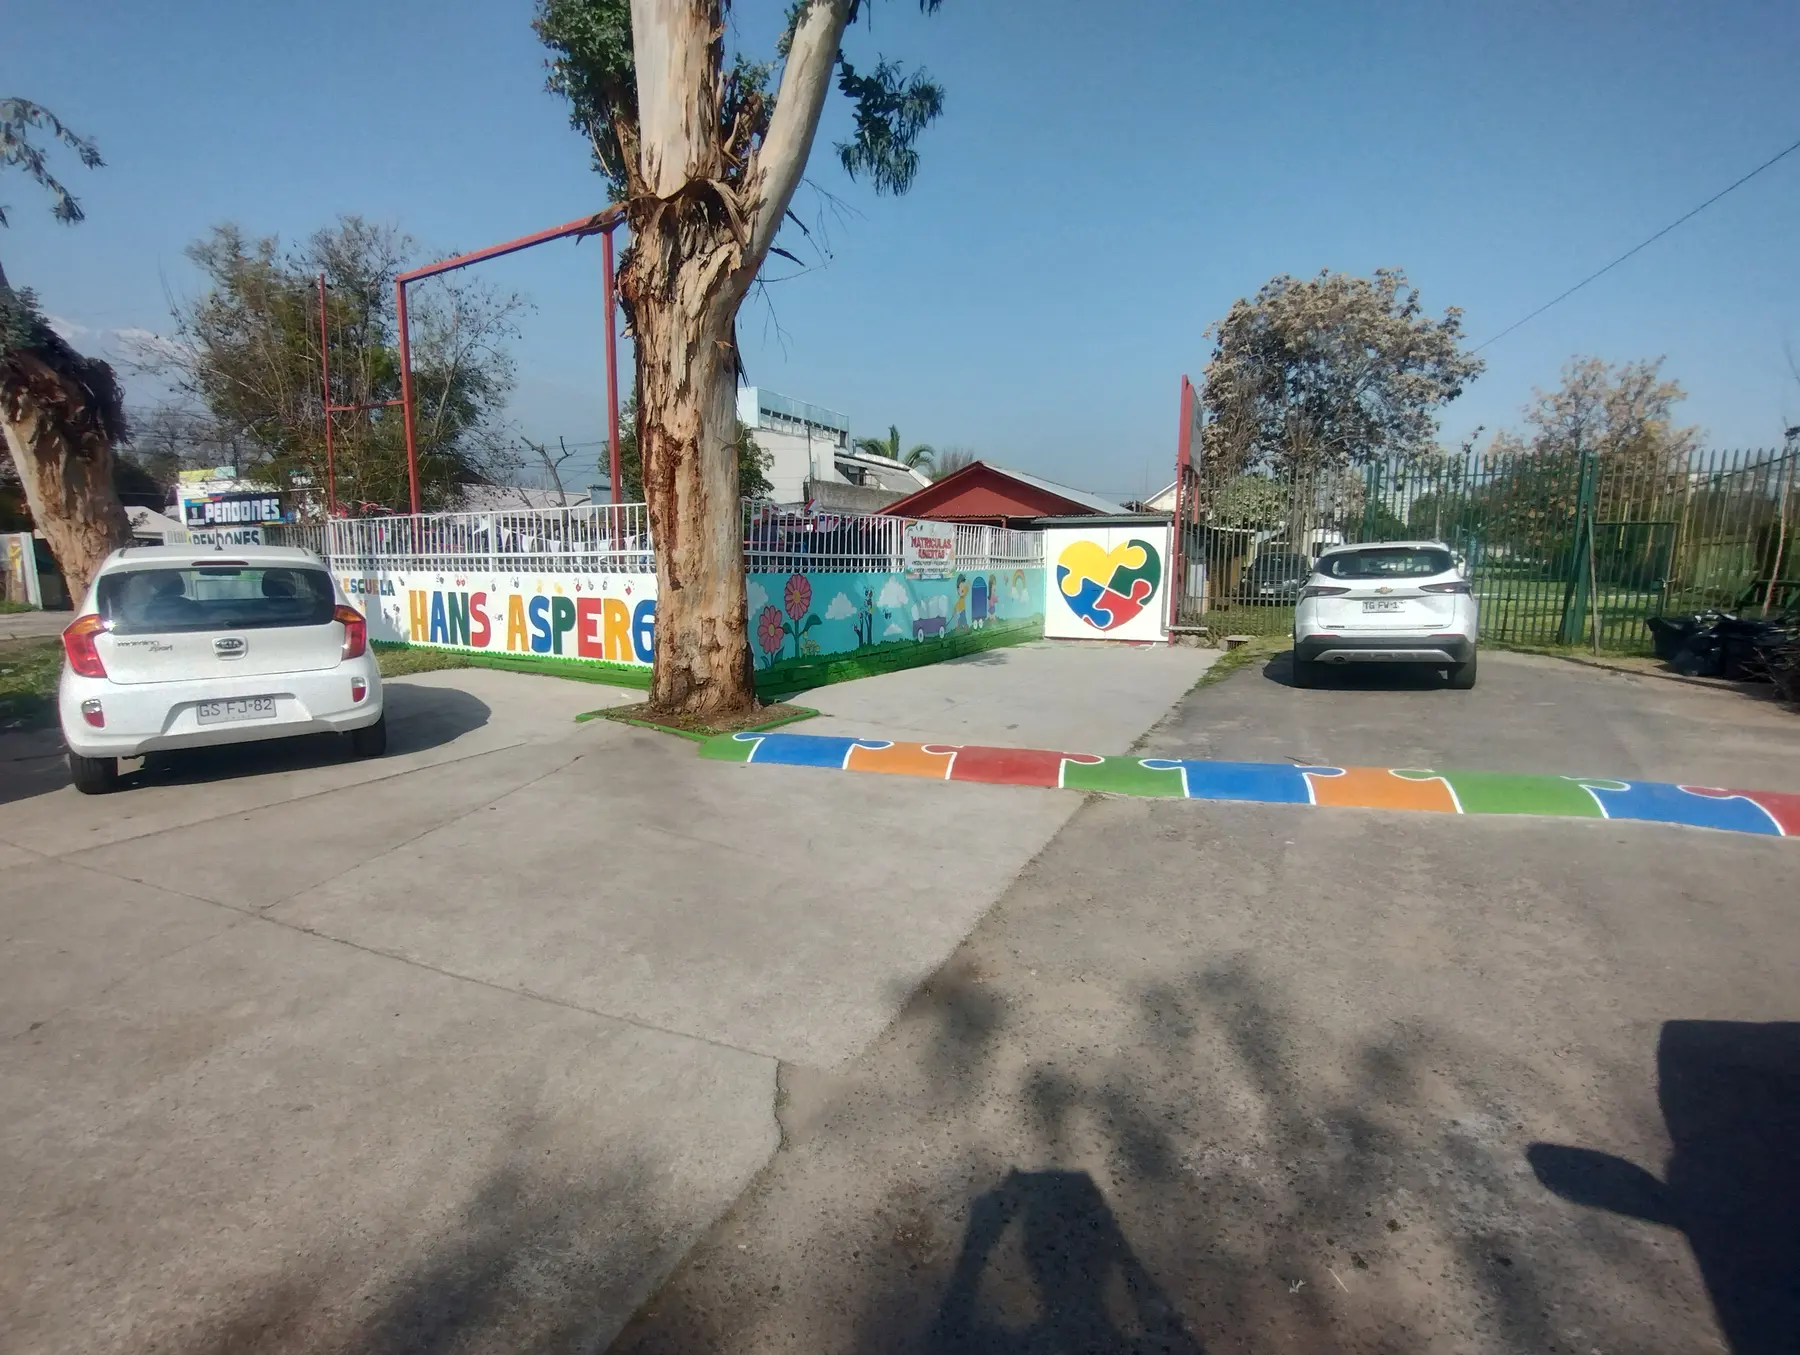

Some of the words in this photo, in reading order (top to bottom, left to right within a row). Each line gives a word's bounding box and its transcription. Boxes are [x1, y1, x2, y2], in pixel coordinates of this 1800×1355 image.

[205, 498, 280, 523] PENDONES
[911, 536, 952, 549] MATRICULAS
[343, 578, 396, 596] ESCUELA
[409, 589, 491, 647] HANS
[507, 594, 656, 663] ASPERG
[200, 703, 221, 717] GS
